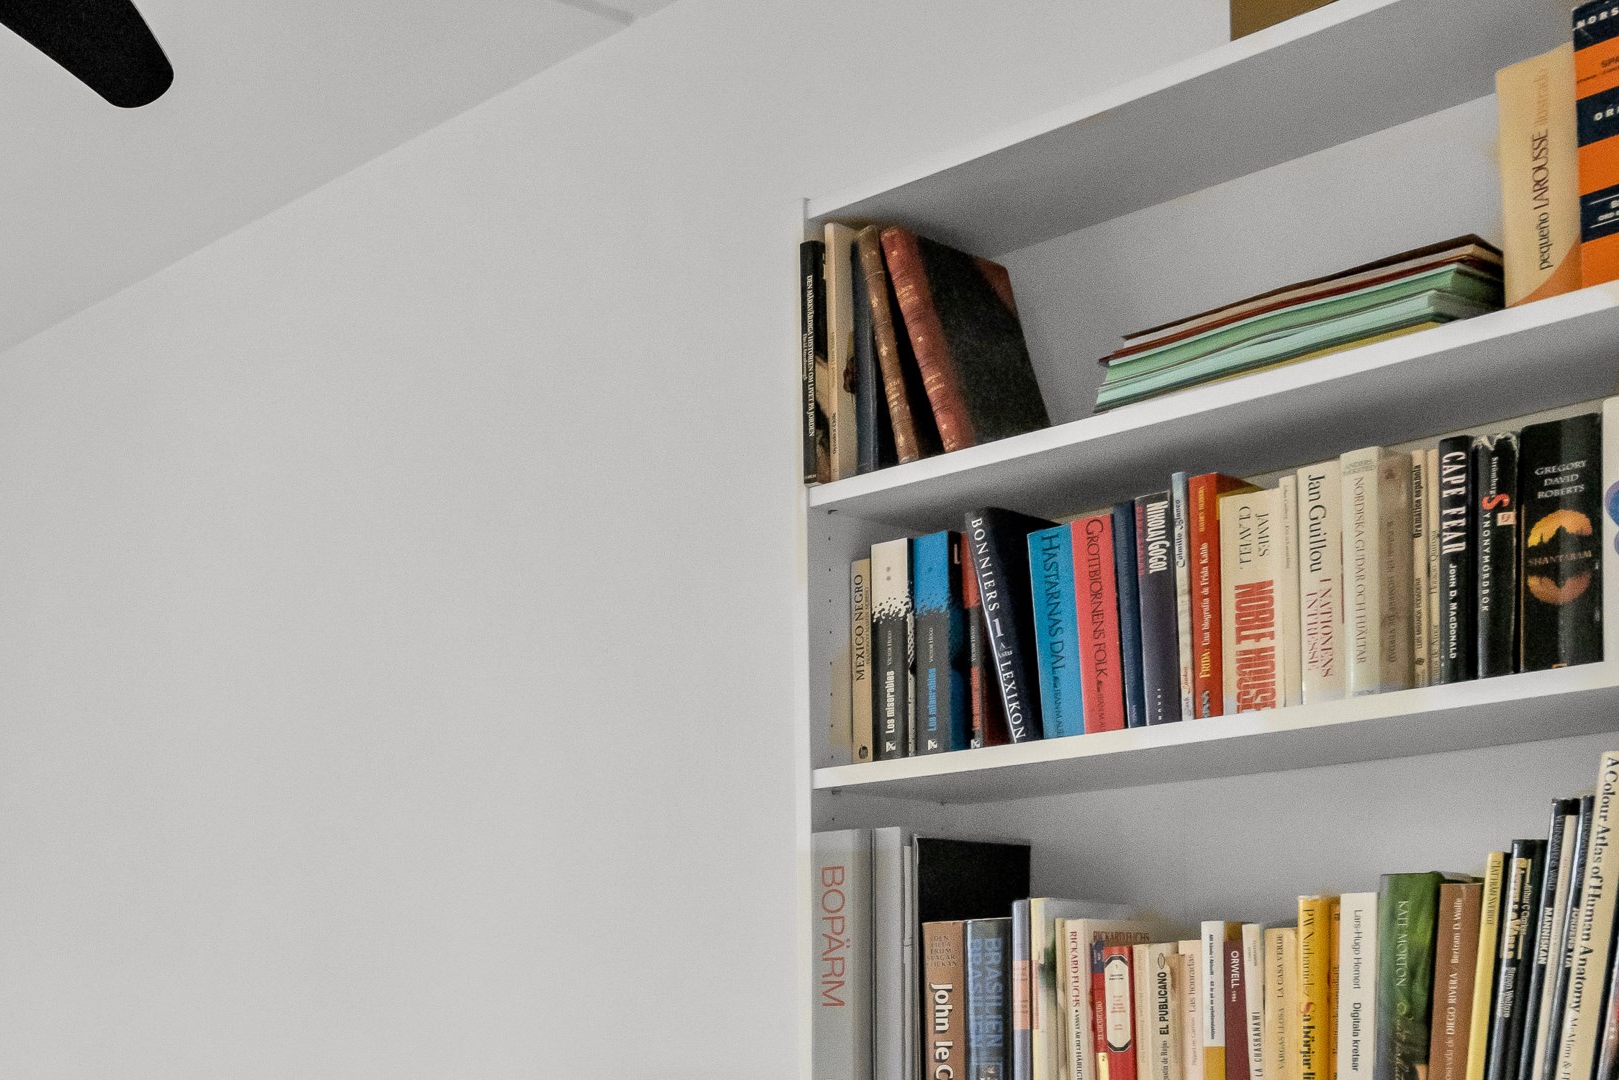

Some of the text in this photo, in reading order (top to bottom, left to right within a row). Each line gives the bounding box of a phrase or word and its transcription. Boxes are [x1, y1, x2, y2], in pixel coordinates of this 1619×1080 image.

[1532, 129, 1553, 270] pequeño LAROUSSE
[808, 372, 814, 382] OM
[807, 411, 815, 436] JORDEN
[1535, 460, 1587, 476] GREGORY
[1538, 484, 1585, 499] ROBERTS
[1544, 474, 1579, 486] DAVID
[1307, 475, 1327, 572] Jan Guillou
[1353, 477, 1365, 580] NORDISKA GUDAR
[1442, 451, 1466, 555] CAPE FEAR
[1145, 501, 1170, 574] NIKOLAJ GOGOL
[1239, 506, 1252, 569] CLAVELL
[1256, 513, 1270, 557] JAMES
[970, 518, 1000, 612] BONNIERS
[1199, 543, 1210, 585] Frida Kahlo
[1449, 563, 1458, 587] JOHN
[854, 575, 865, 681] MEXICO NEGRO
[1234, 580, 1276, 713] NOBLE HOUSE
[1306, 590, 1319, 670] INTRESSE
[1320, 587, 1333, 678] NATIONENS
[1051, 641, 1067, 674] DAL
[1094, 643, 1107, 677] FOLK
[885, 671, 895, 733] Los miserables
[1001, 661, 1026, 739] LEXIKON
[1397, 900, 1409, 929] KATE
[1568, 770, 1617, 1013] Colour Atlas of Human Anatomy
[821, 865, 851, 1007] BOPÄRM
[1069, 931, 1079, 973] RICKARD
[1352, 909, 1363, 990] Lars-Hugo Hemert
[1395, 934, 1409, 987] MORTON
[984, 937, 1003, 1048] BRASILIEN
[1071, 975, 1081, 1007] FUCHS
[1187, 954, 1196, 1012] Las honradas
[1230, 950, 1240, 989] ORWELL
[1277, 987, 1284, 998] LA
[930, 983, 953, 1033] John
[1157, 972, 1169, 1035] EL PUBLICANO
[1446, 972, 1459, 1035] DIEGO RIVERA
[934, 1041, 952, 1062] le
[1299, 1025, 1316, 1069] börjar
[1350, 1002, 1362, 1072] Digitala kretsar
[1075, 1051, 1084, 1080] HÄRLIGT
[1255, 1068, 1264, 1077] LA
